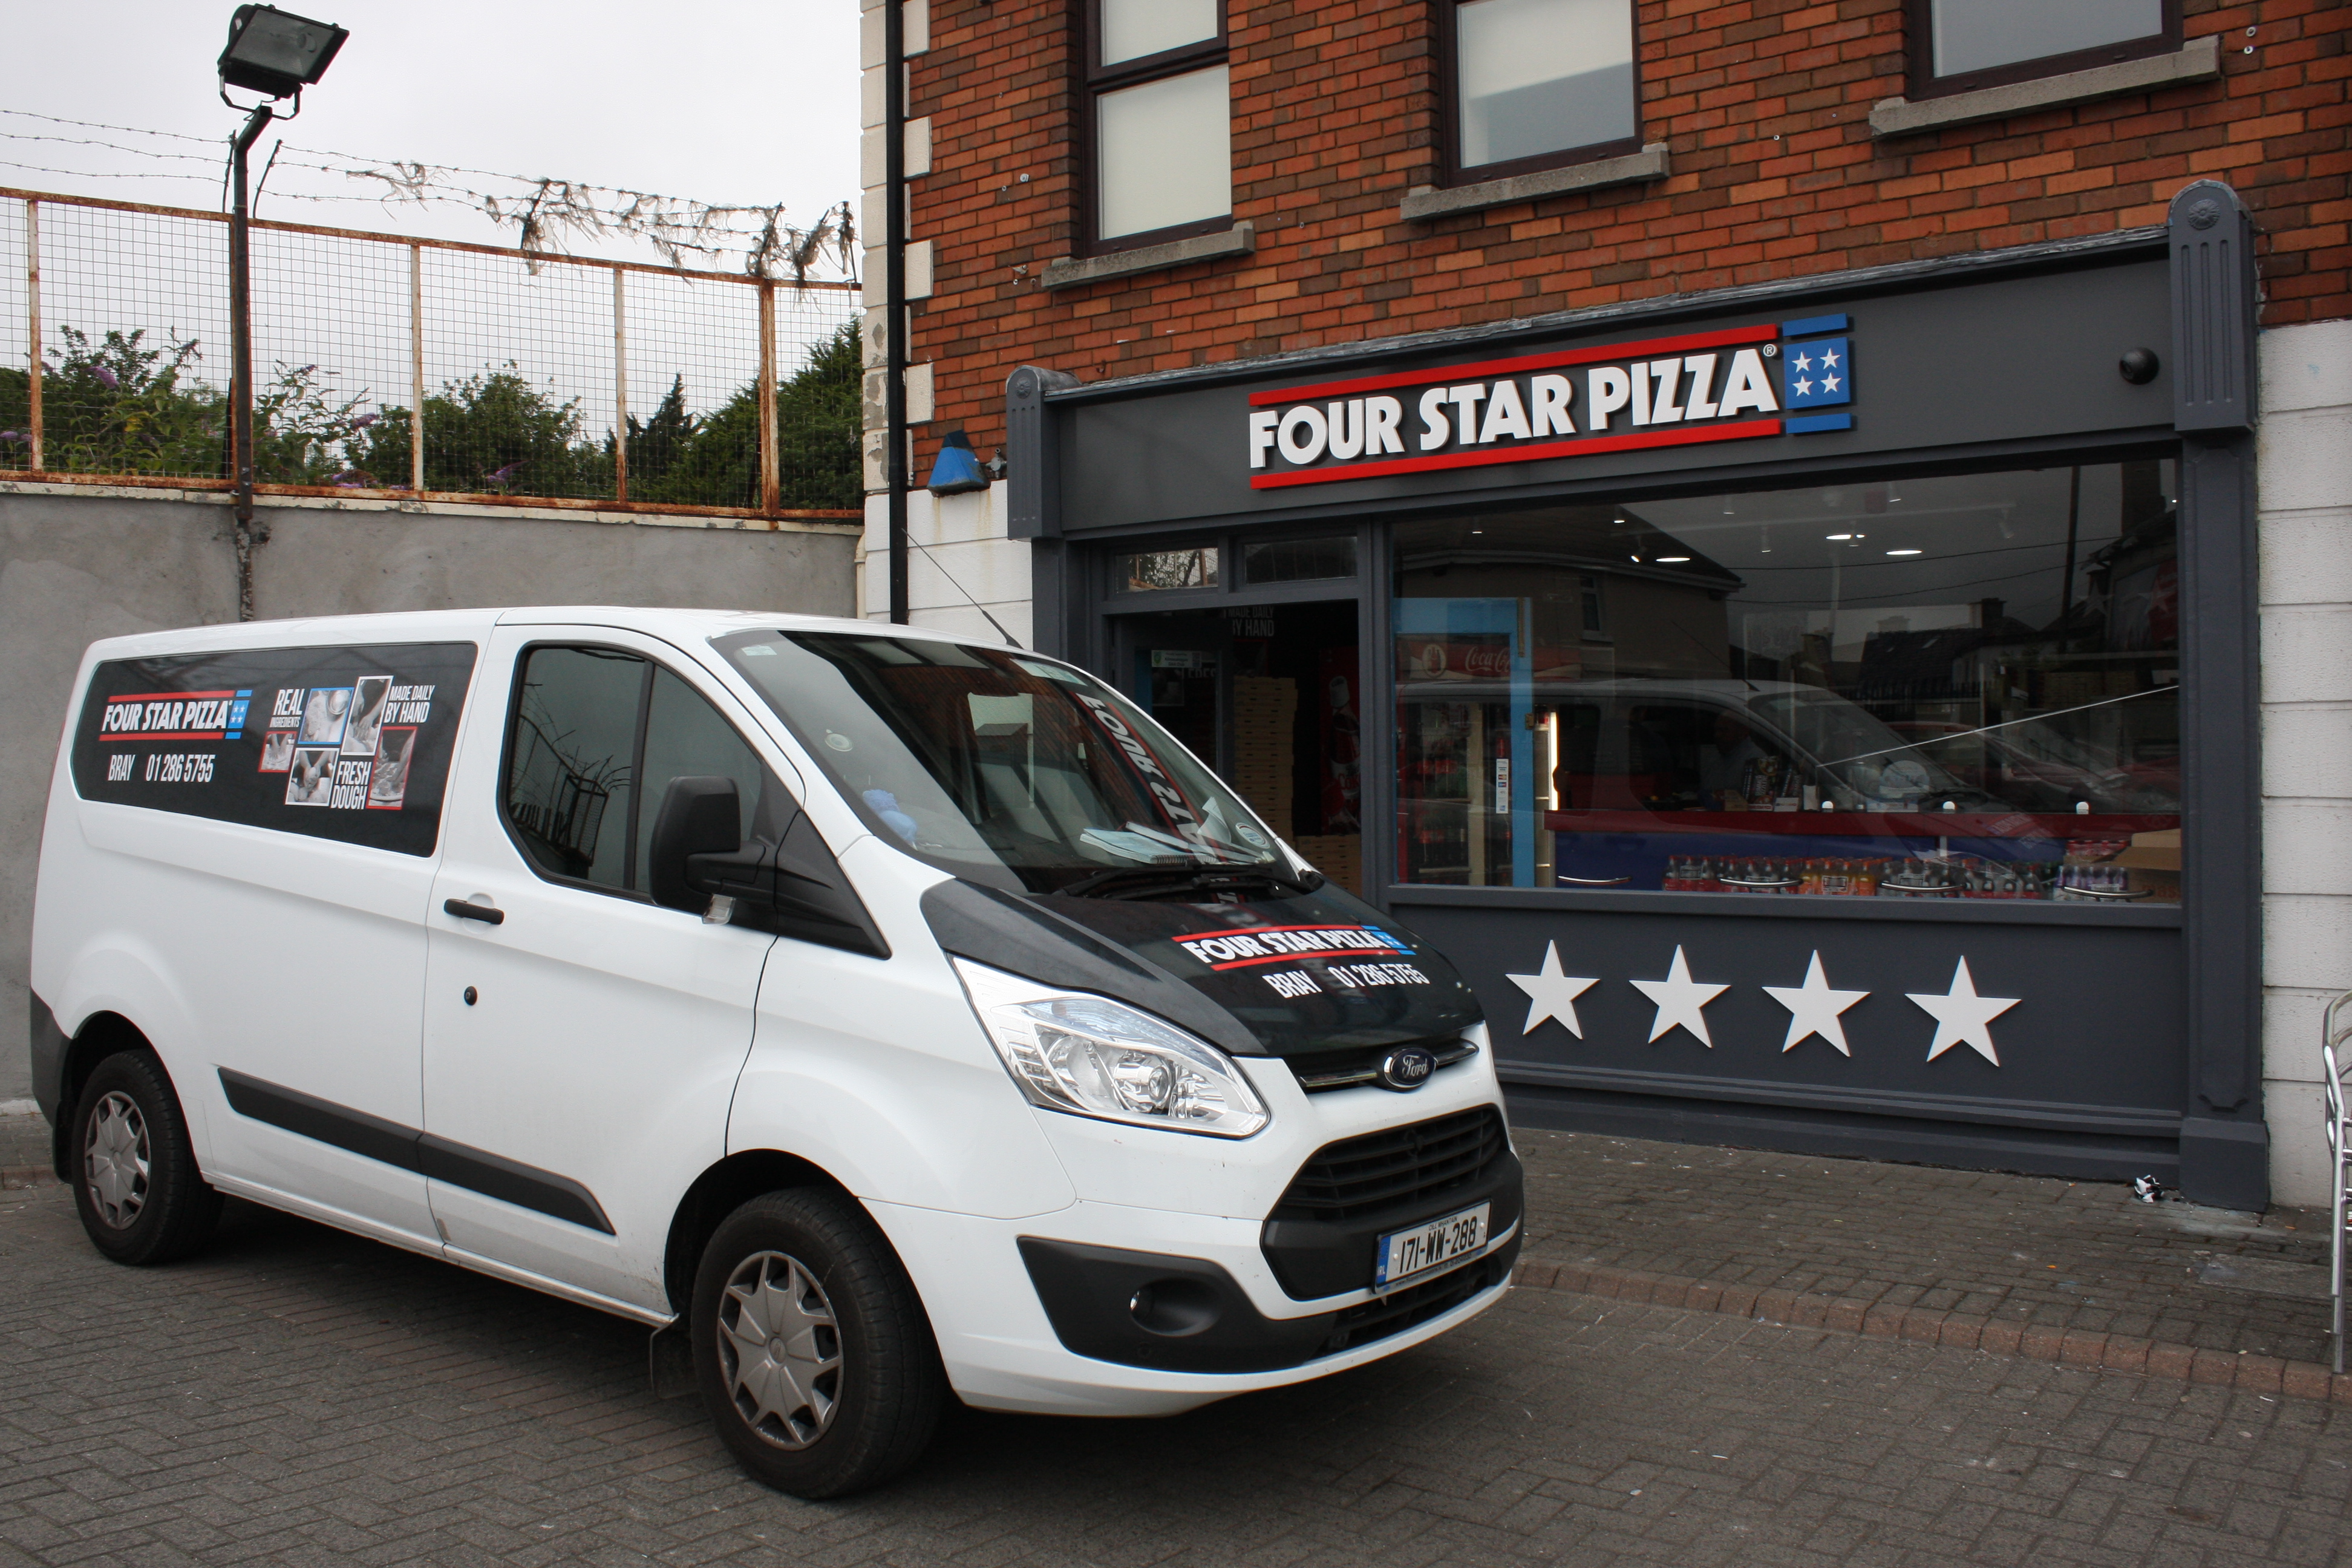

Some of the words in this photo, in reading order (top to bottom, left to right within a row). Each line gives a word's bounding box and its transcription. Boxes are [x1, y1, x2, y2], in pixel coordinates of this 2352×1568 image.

[1249, 396, 1405, 469] FOUR
[1419, 374, 1576, 451] STAR
[1587, 348, 1780, 431] PIZZA
[1252, 606, 1275, 619] DAILY
[1245, 619, 1275, 637] HAND
[273, 688, 305, 716] REAL
[389, 685, 411, 701] MADE
[411, 685, 436, 701] DAILY
[101, 703, 143, 732] FOUR
[142, 702, 184, 731] STAR
[181, 700, 229, 730] PIZZA
[269, 716, 301, 728] INGREDIENTS
[383, 702, 400, 724] BY
[399, 702, 431, 724] HAND
[108, 754, 136, 782] BRAY
[145, 754, 162, 782] 01
[160, 754, 185, 782] 286
[183, 754, 216, 783] 5755
[335, 760, 373, 786] FRESH
[331, 785, 368, 810] DOUGH
[1181, 935, 1274, 963] FOUR
[1257, 930, 1326, 953] STAR
[1315, 930, 1391, 949] PIZZA
[1262, 970, 1322, 998] BRAY
[1327, 965, 1366, 988] 01
[1353, 964, 1393, 986] 286
[1380, 963, 1431, 985] 5755
[1402, 1054, 1429, 1078] Ford
[1399, 1216, 1477, 1274] 171-WW-288
[1377, 1265, 1386, 1276] IRL
